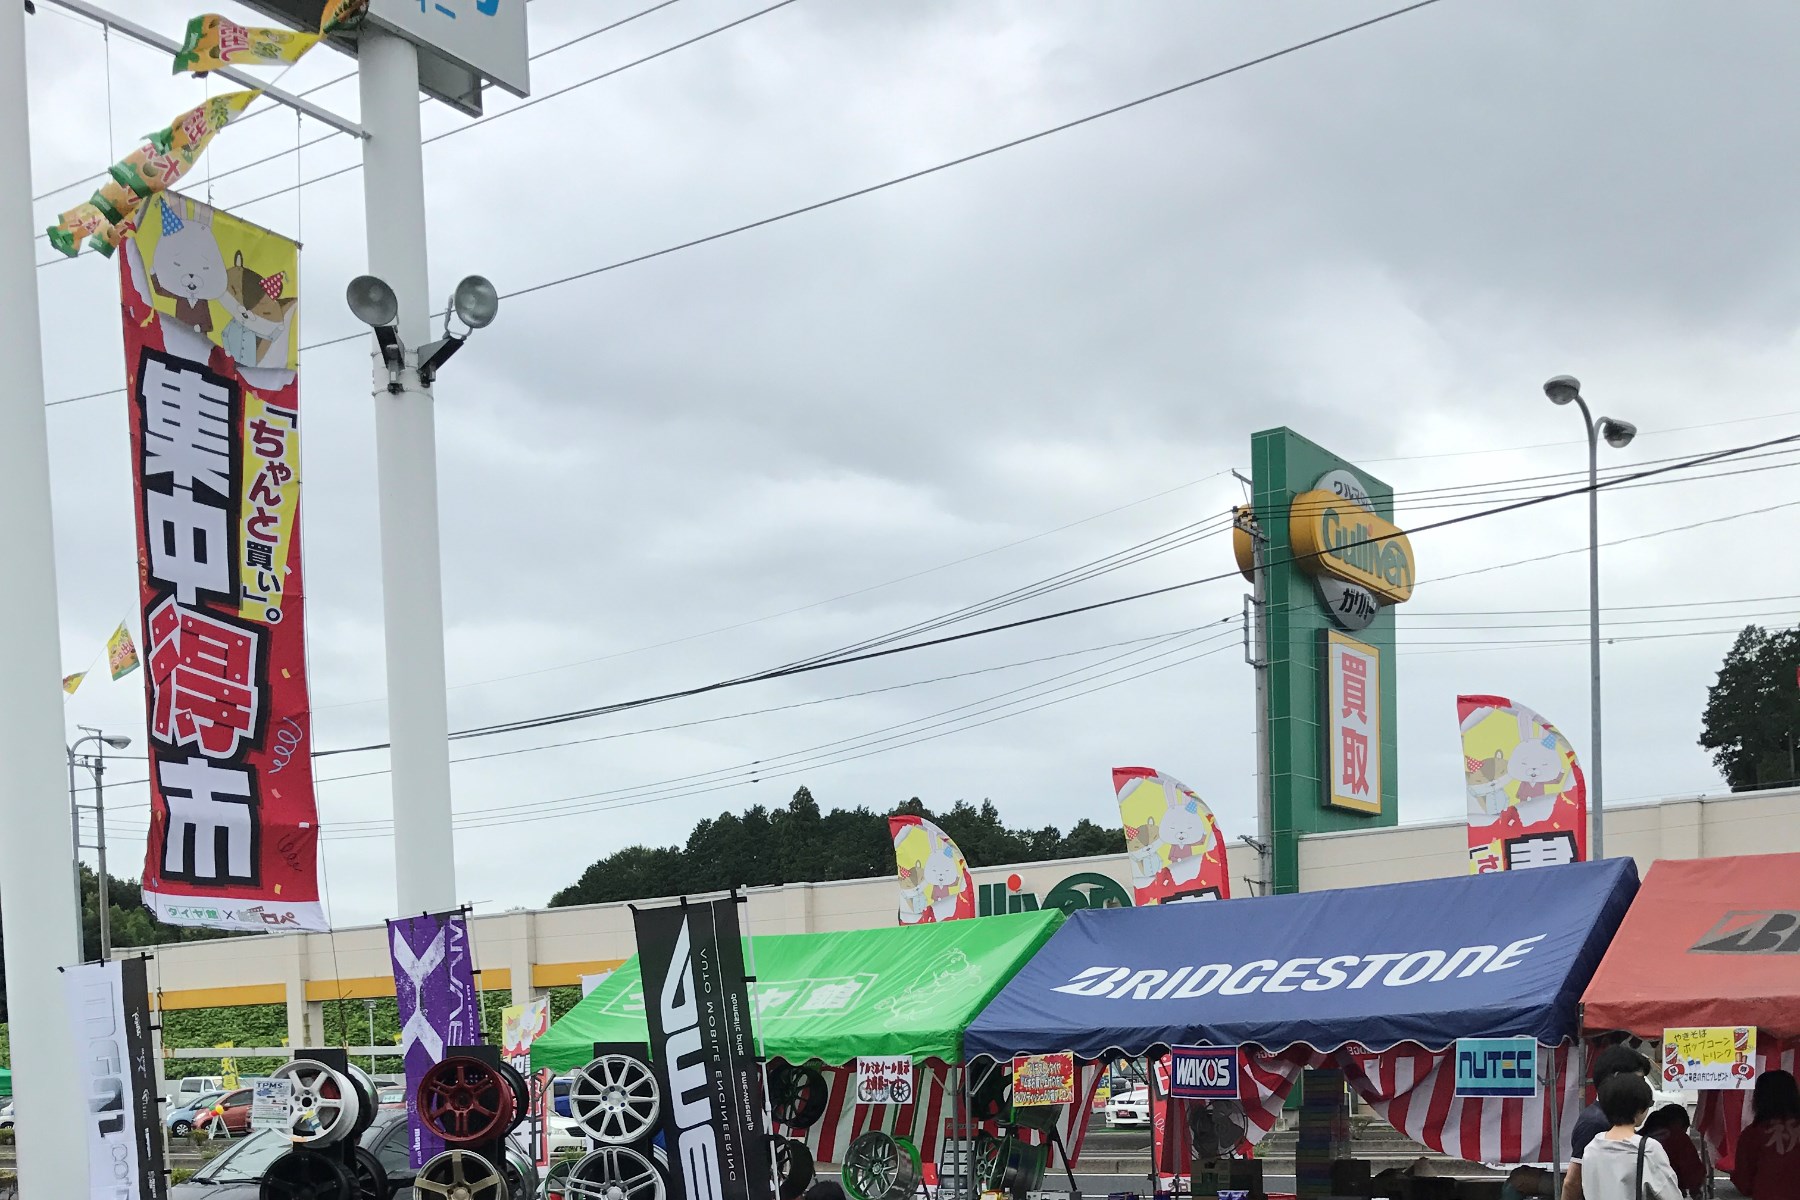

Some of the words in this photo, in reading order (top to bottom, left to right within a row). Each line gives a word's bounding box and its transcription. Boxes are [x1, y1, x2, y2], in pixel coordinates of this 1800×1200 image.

[1322, 508, 1412, 594] Gulliver
[1341, 651, 1370, 797] 買取
[1050, 933, 1548, 1001] BRIDGESTONE
[1176, 1057, 1230, 1087] WAKO'S
[1459, 1051, 1532, 1079] NUTEC
